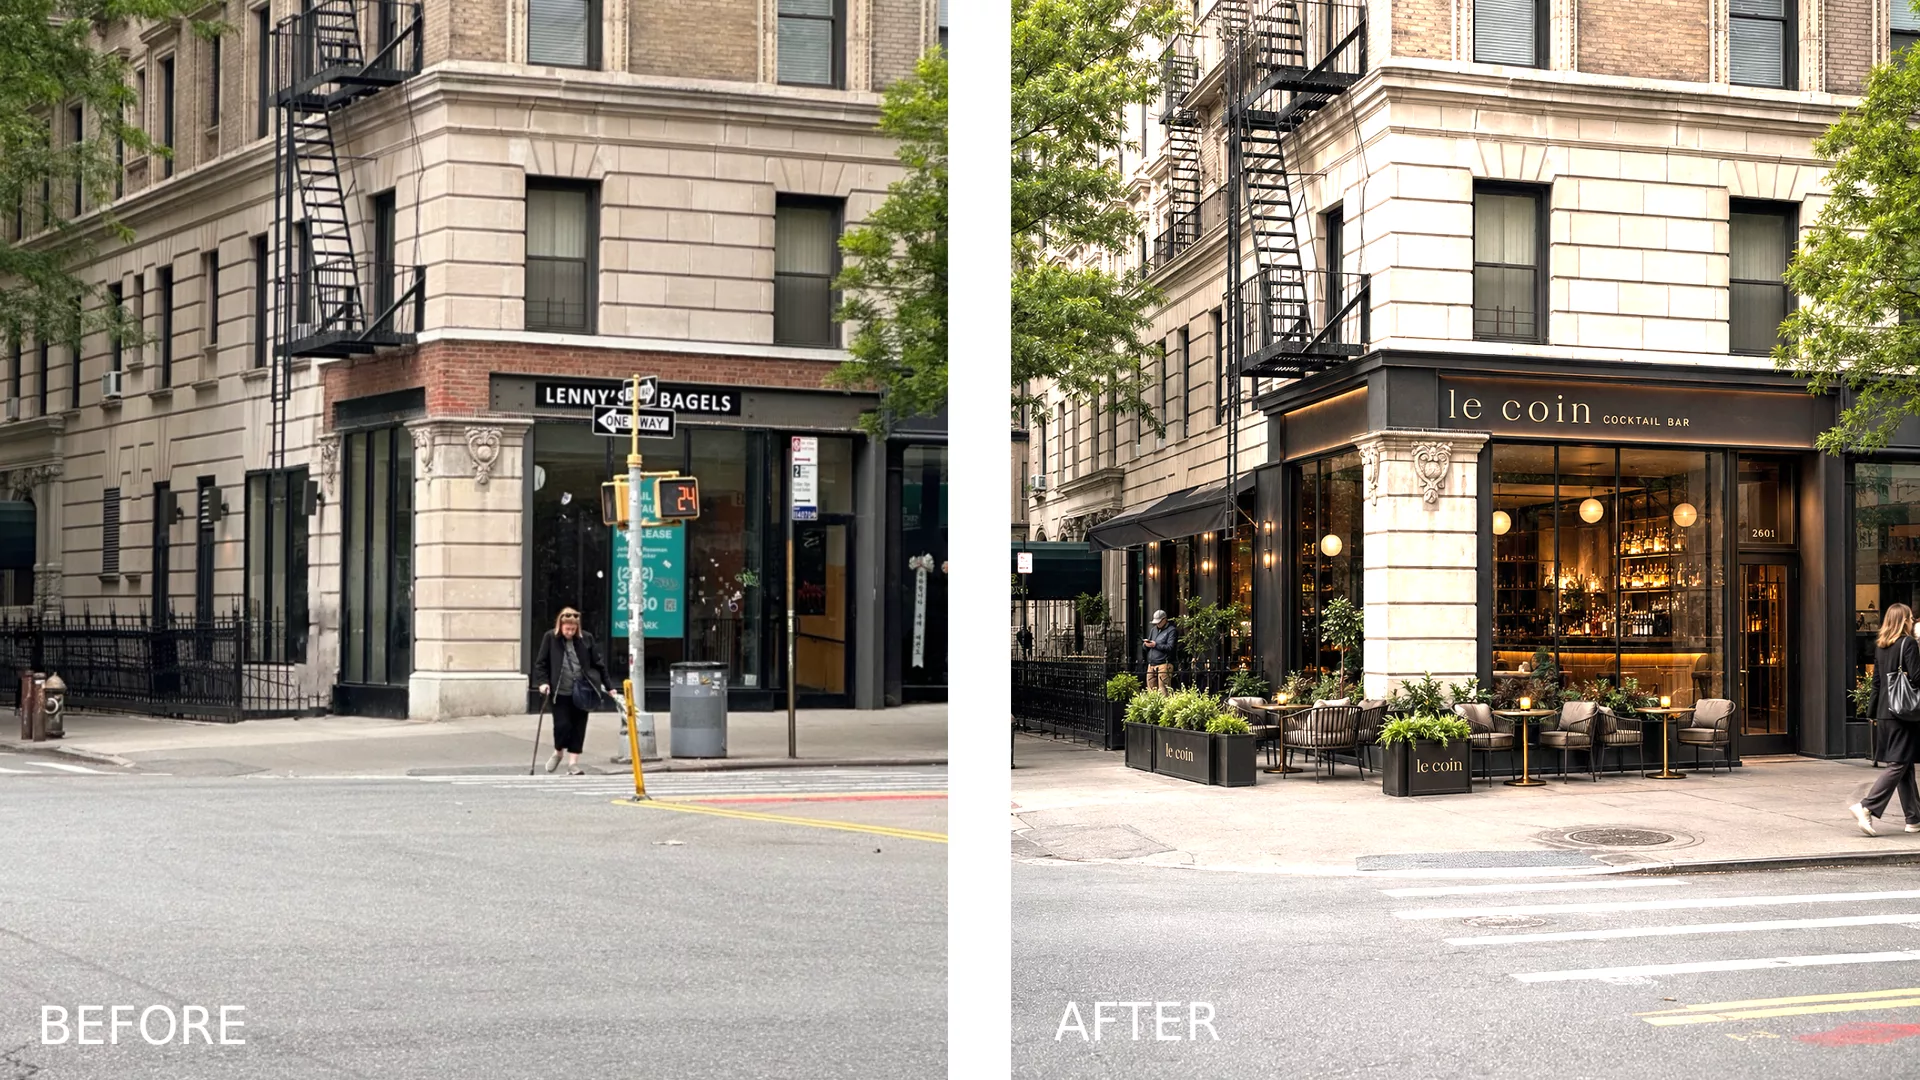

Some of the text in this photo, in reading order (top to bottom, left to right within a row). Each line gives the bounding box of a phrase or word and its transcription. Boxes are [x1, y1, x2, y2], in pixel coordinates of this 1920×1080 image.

[546, 387, 624, 406] LENNY'S
[660, 392, 731, 411] BAGELS
[1448, 389, 1592, 424] le coin
[606, 415, 664, 429] ONE WAY
[1602, 415, 1690, 427] COCKTAIL BAR
[677, 486, 696, 511] 24
[1752, 529, 1775, 538] 2601
[617, 566, 653, 582] (22)
[1165, 742, 1194, 762] le coin
[1416, 757, 1463, 773] le coin
